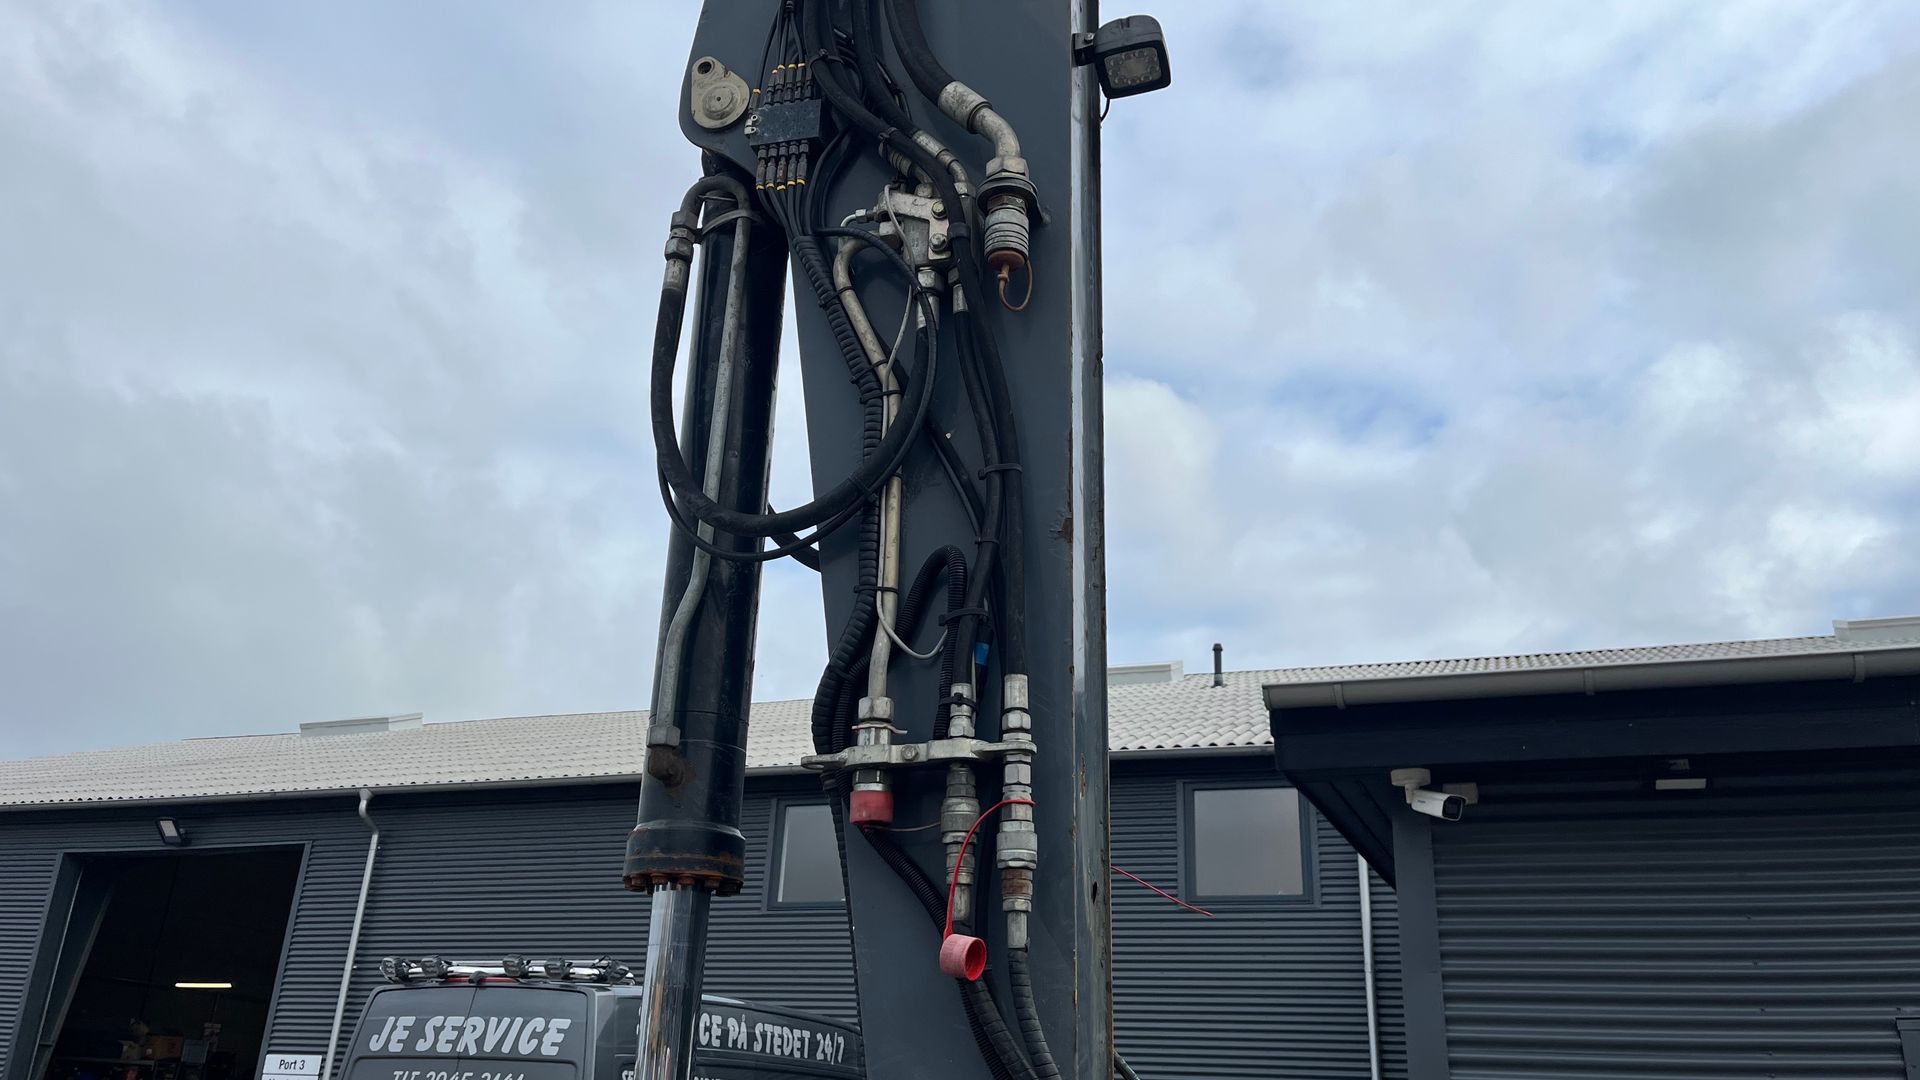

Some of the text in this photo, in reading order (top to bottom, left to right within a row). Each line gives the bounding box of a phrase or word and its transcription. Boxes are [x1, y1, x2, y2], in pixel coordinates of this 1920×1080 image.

[369, 1016, 571, 1056] JE SERVICE
[727, 1013, 747, 1050] PÅ
[753, 1022, 811, 1059] STEDET
[815, 1031, 845, 1065] 24/7
[279, 1060, 306, 1070] Port 3
